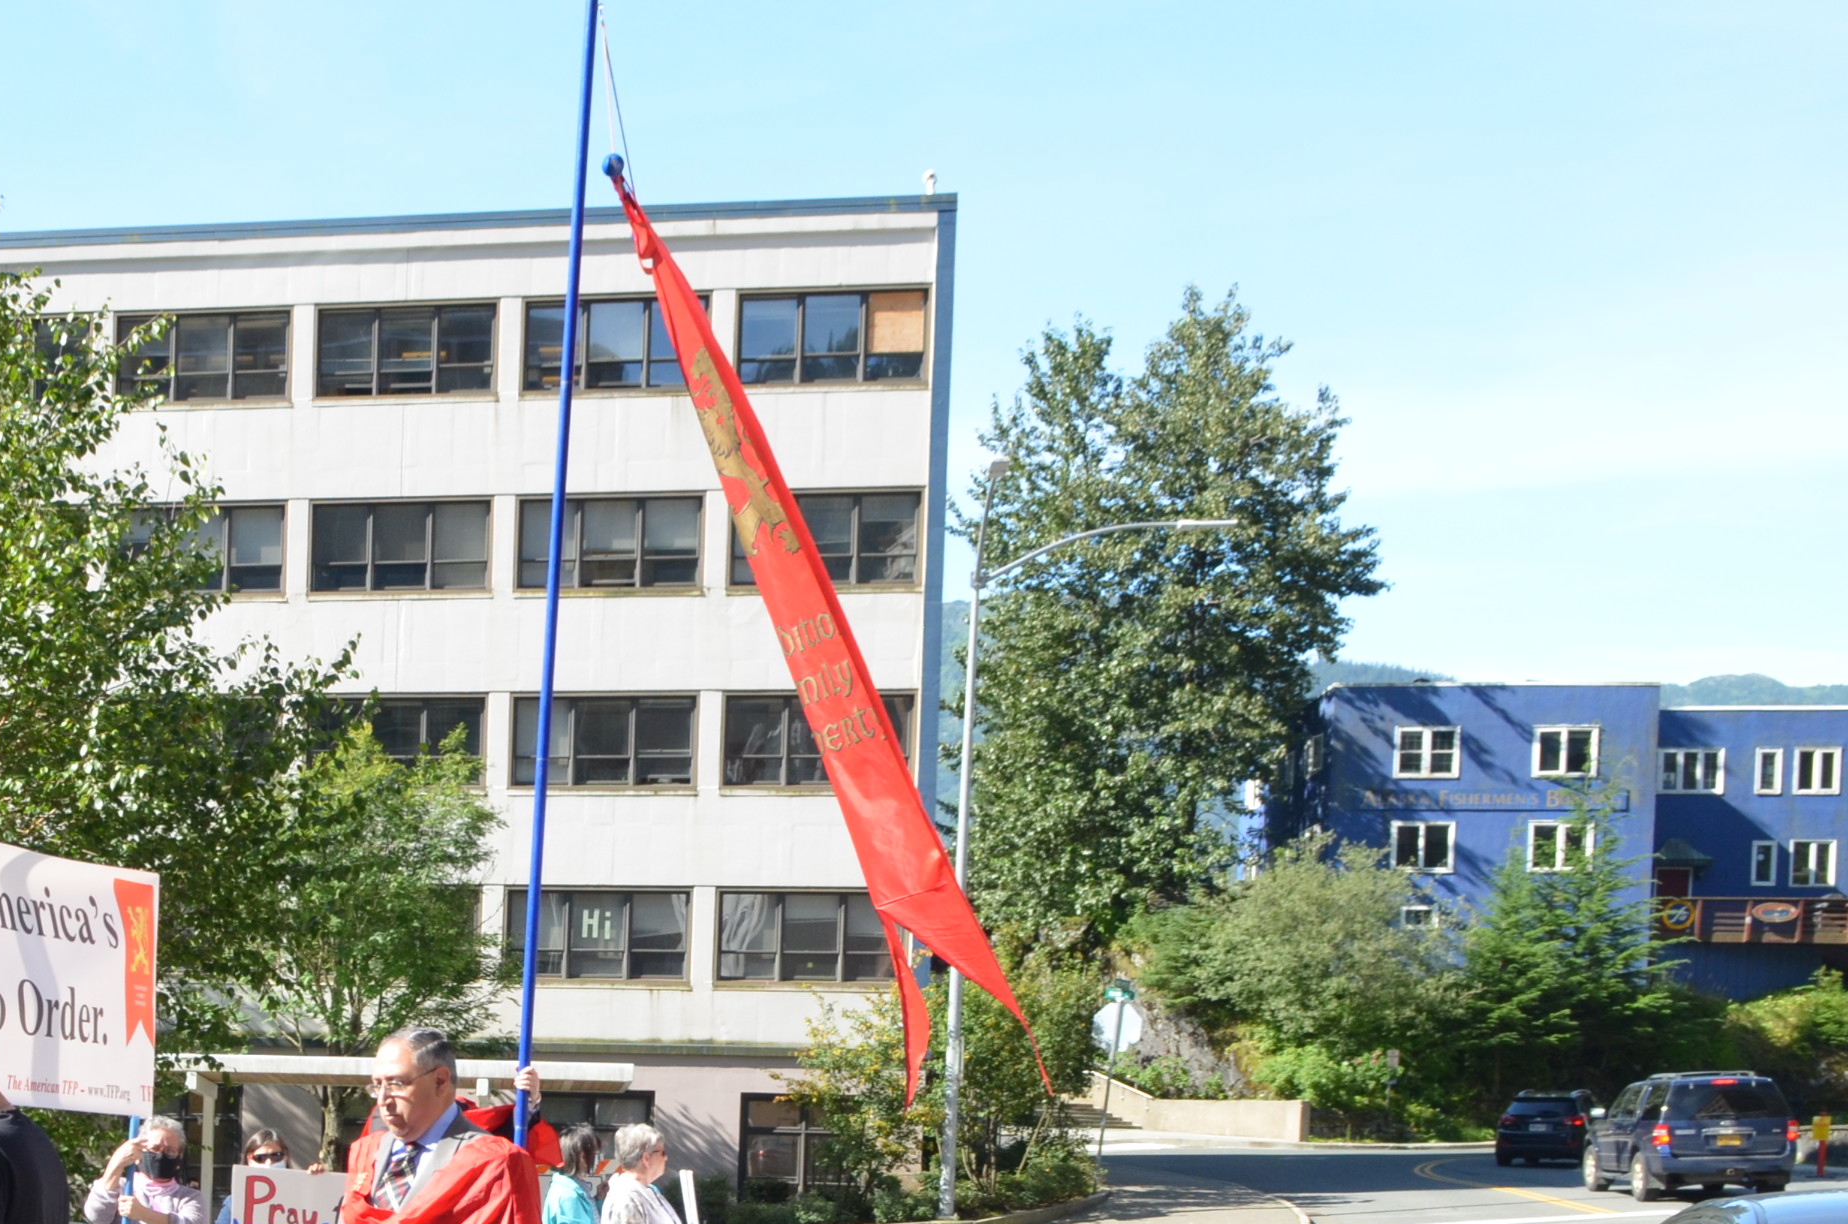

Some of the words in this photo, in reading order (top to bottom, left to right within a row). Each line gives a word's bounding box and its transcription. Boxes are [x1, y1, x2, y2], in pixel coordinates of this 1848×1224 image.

[581, 908, 611, 940] Hi
[17, 979, 109, 1047] Order.
[7, 1075, 22, 1090] The
[24, 1077, 59, 1094] American
[62, 1080, 79, 1096] TFP
